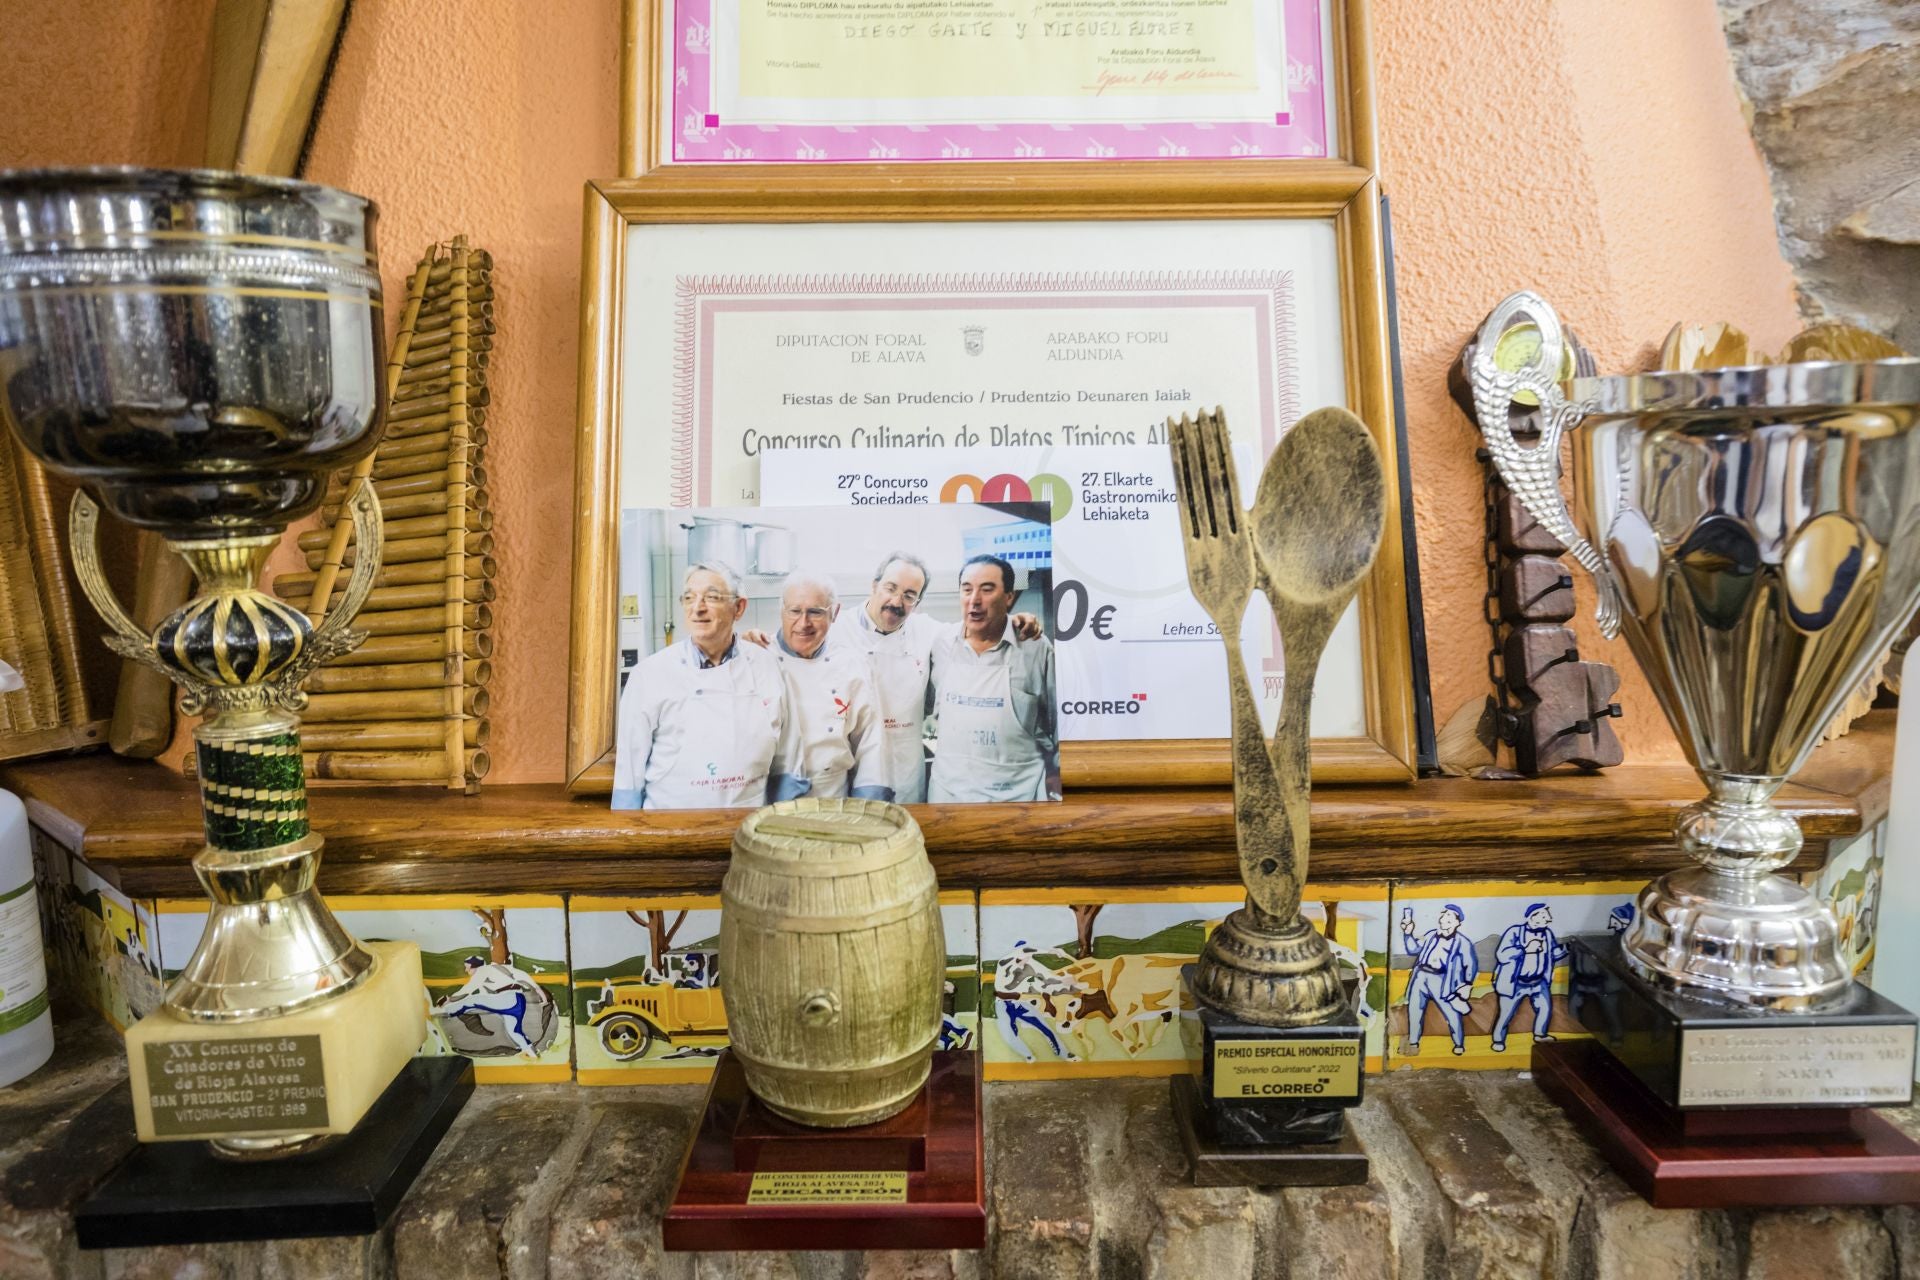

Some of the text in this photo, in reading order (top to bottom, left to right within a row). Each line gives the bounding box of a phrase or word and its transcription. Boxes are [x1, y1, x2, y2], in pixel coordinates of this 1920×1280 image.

[844, 23, 915, 39] DIEGO
[1043, 20, 1121, 38] MIGUEL
[776, 334, 927, 347] DIPUTACION FORAL
[1046, 331, 1169, 344] ARABAKO FORU
[851, 350, 926, 363] DE ALAVA
[1047, 348, 1124, 361] ALDUNDIA
[782, 393, 834, 405] Fiestas
[839, 392, 858, 405] de
[863, 392, 891, 404] San
[897, 391, 974, 405] Prudencio
[991, 390, 1071, 403] Prudentzio
[1077, 390, 1149, 402] Deunaren
[1154, 388, 1192, 402] Jaiak
[742, 428, 842, 457] Concurso
[851, 424, 945, 448] Culinario
[954, 424, 980, 447] de
[864, 474, 929, 489] Concurso
[1081, 472, 1153, 487] 27. Elkarte
[851, 491, 929, 505] Sociedades
[1083, 506, 1150, 521] Lehiaketa
[1163, 622, 1203, 636] Lehen
[1061, 700, 1140, 715] CORREO
[169, 1038, 297, 1058] XX Concurso de
[1217, 1044, 1356, 1059] PREMIO ESPECIAL HONORÍFICO
[246, 1056, 265, 1070] de
[270, 1055, 306, 1068] Vino
[1317, 1064, 1341, 1073] 2022
[175, 1072, 300, 1091] de Rioja Alavesa
[182, 1090, 254, 1106] PRUDENCIO
[283, 1086, 327, 1100] PREMIO
[1242, 1083, 1325, 1096] EL CORREO
[175, 1104, 276, 1122] VITORIA-GASTEIZ
[751, 1187, 903, 1196] SUBCAMPEÓN
[810, 1180, 860, 1188] ALAVESA
